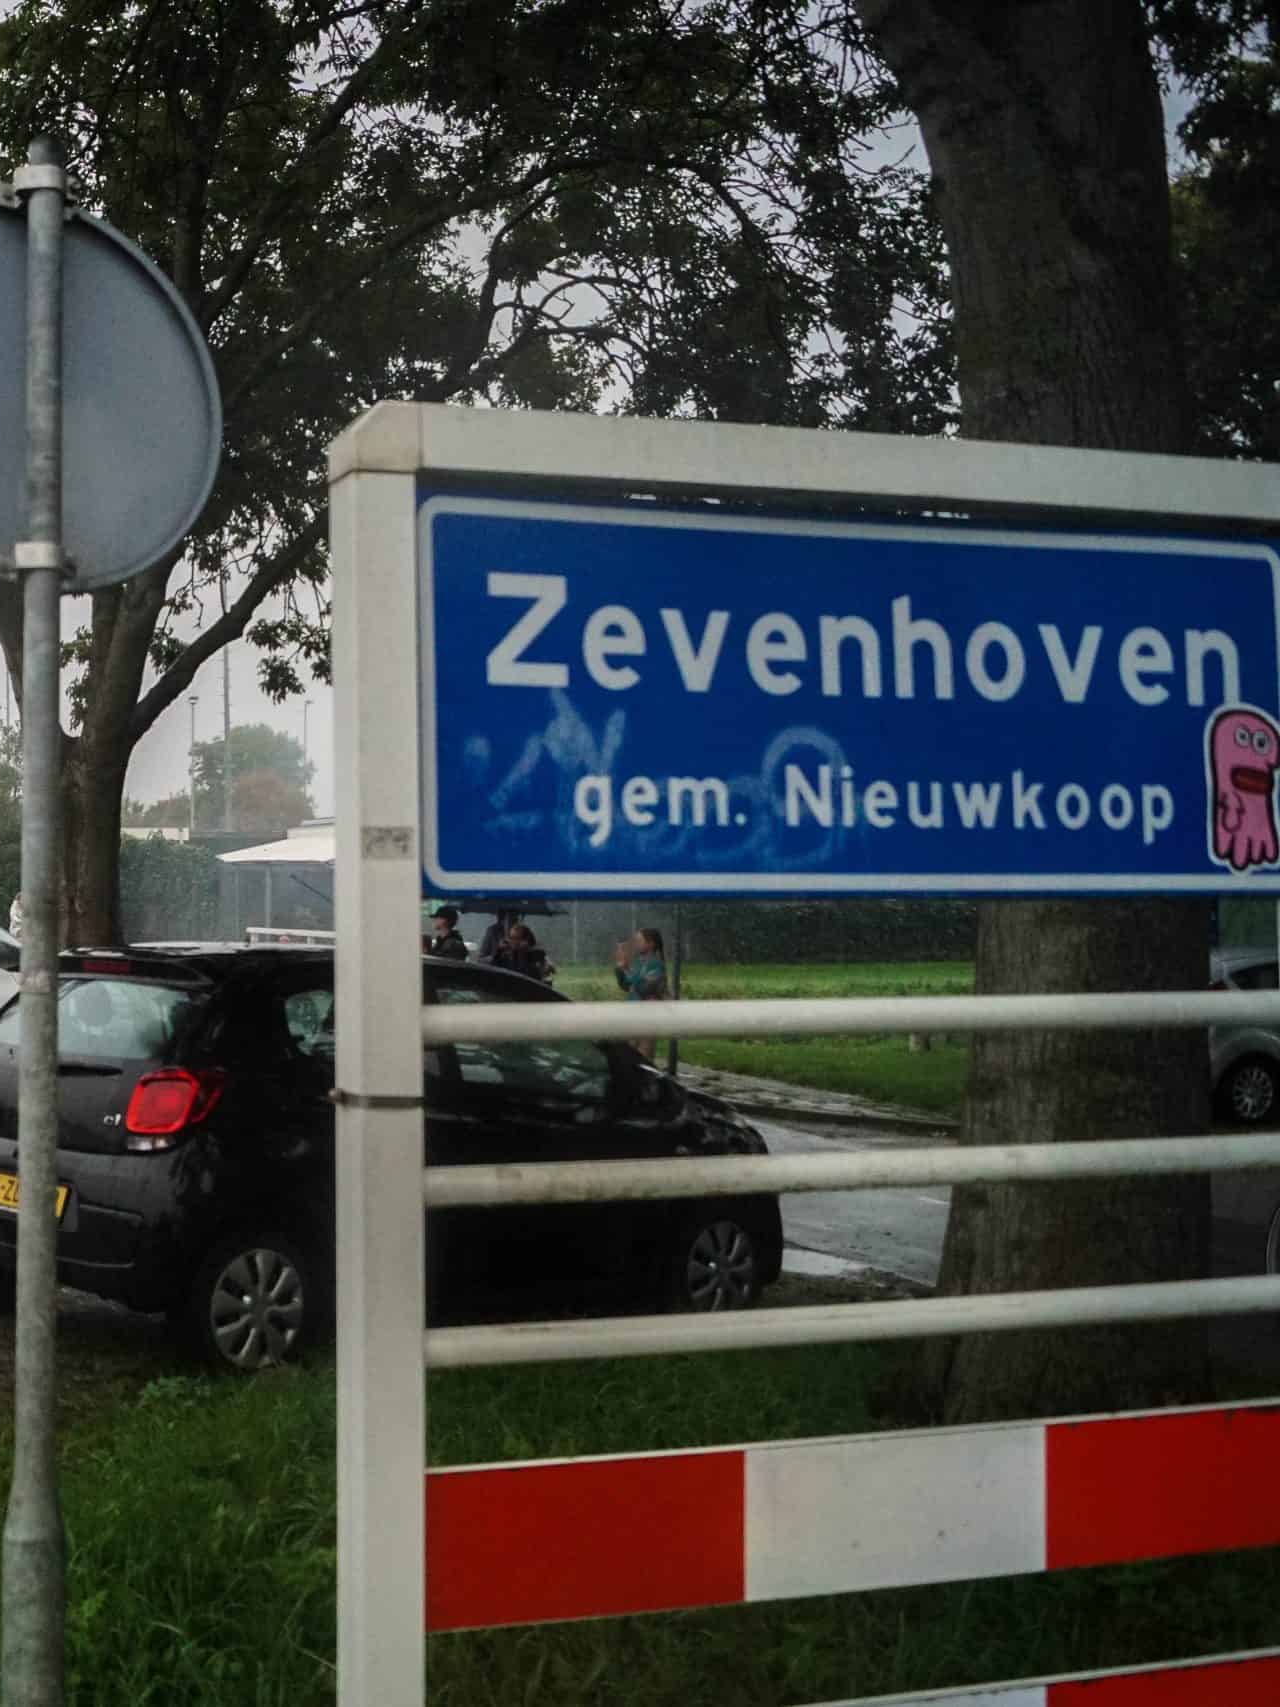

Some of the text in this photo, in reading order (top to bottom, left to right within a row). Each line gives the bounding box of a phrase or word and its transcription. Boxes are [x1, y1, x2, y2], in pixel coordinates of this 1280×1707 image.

[487, 571, 1240, 706] Zevenhoven
[574, 764, 1174, 848] gem. Nieuwkoop
